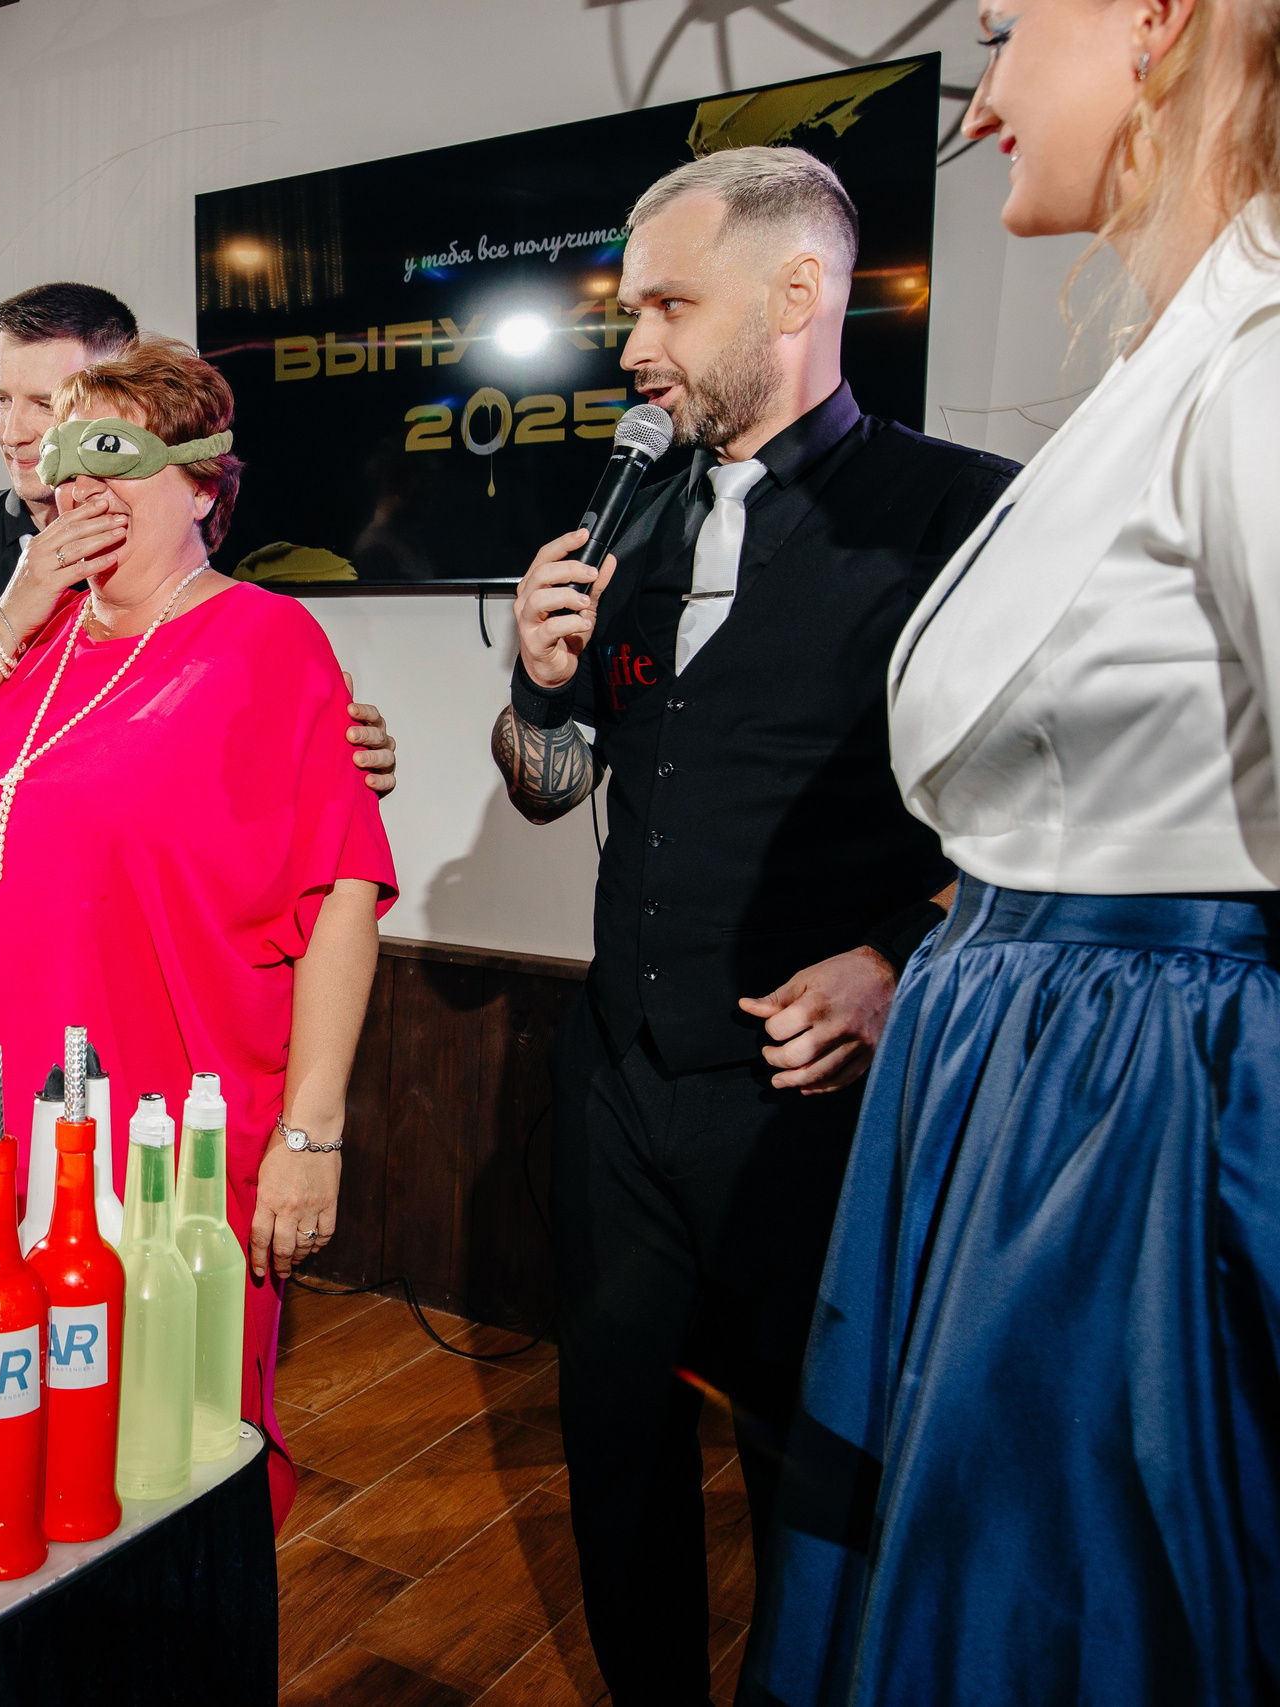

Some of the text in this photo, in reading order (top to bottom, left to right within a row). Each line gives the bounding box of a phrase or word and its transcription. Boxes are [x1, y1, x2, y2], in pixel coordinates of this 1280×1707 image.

[404, 226, 630, 282] у тебя все получится
[275, 297, 637, 382] ВЫПУКН
[404, 387, 627, 454] 2025
[50, 1323, 99, 1365] AR
